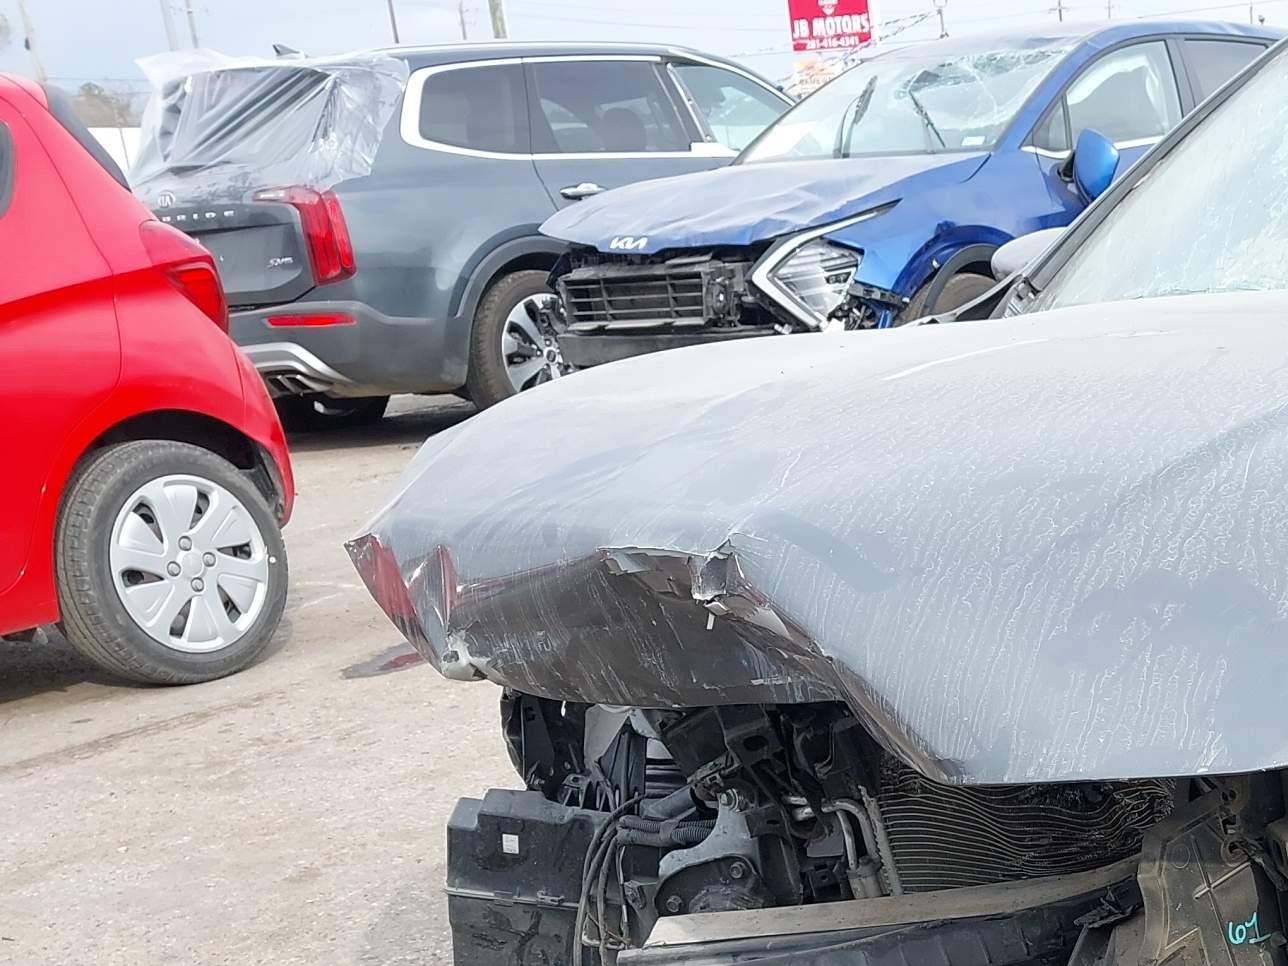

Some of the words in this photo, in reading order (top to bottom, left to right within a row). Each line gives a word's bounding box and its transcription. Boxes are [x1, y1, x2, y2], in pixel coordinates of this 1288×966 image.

[793, 18, 810, 39] JB
[812, 13, 870, 37] MOTORS
[610, 236, 648, 249] KIA
